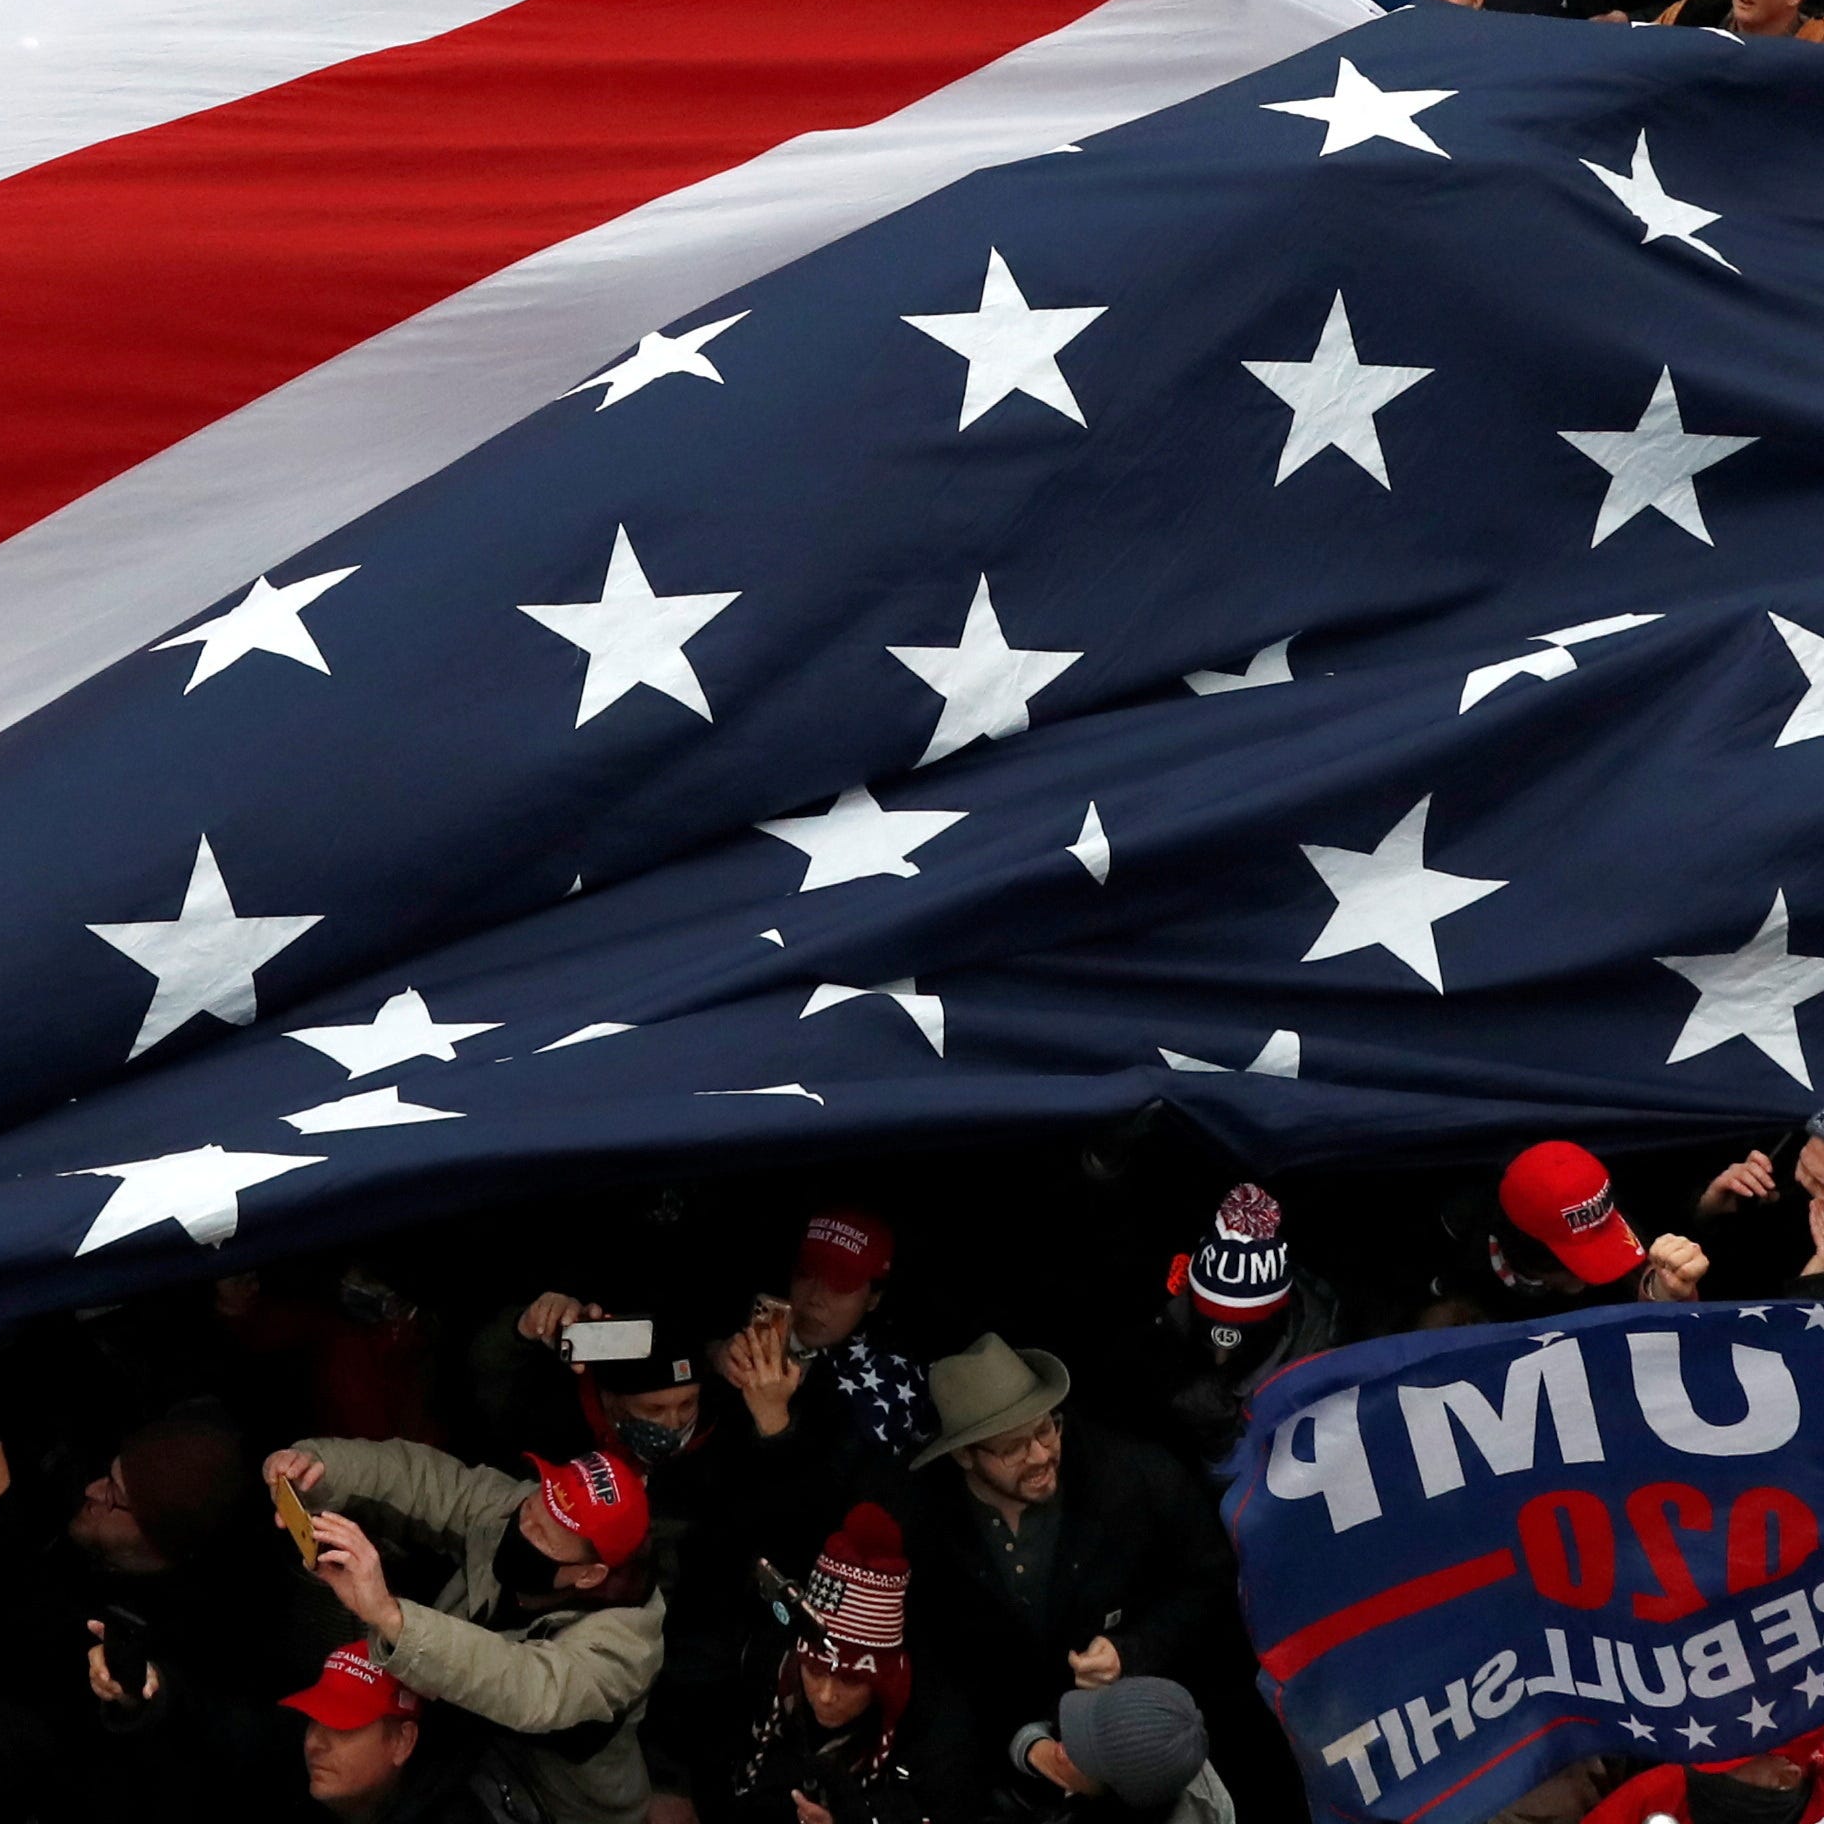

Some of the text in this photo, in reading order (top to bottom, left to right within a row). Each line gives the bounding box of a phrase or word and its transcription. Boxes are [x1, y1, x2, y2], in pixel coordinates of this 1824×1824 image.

[829, 1219, 871, 1246] AMERICA
[835, 1234, 863, 1255] AGAIN
[1215, 1326, 1237, 1344] 45
[345, 1652, 384, 1677] AMERICA
[345, 1665, 376, 1685] AGAIN
